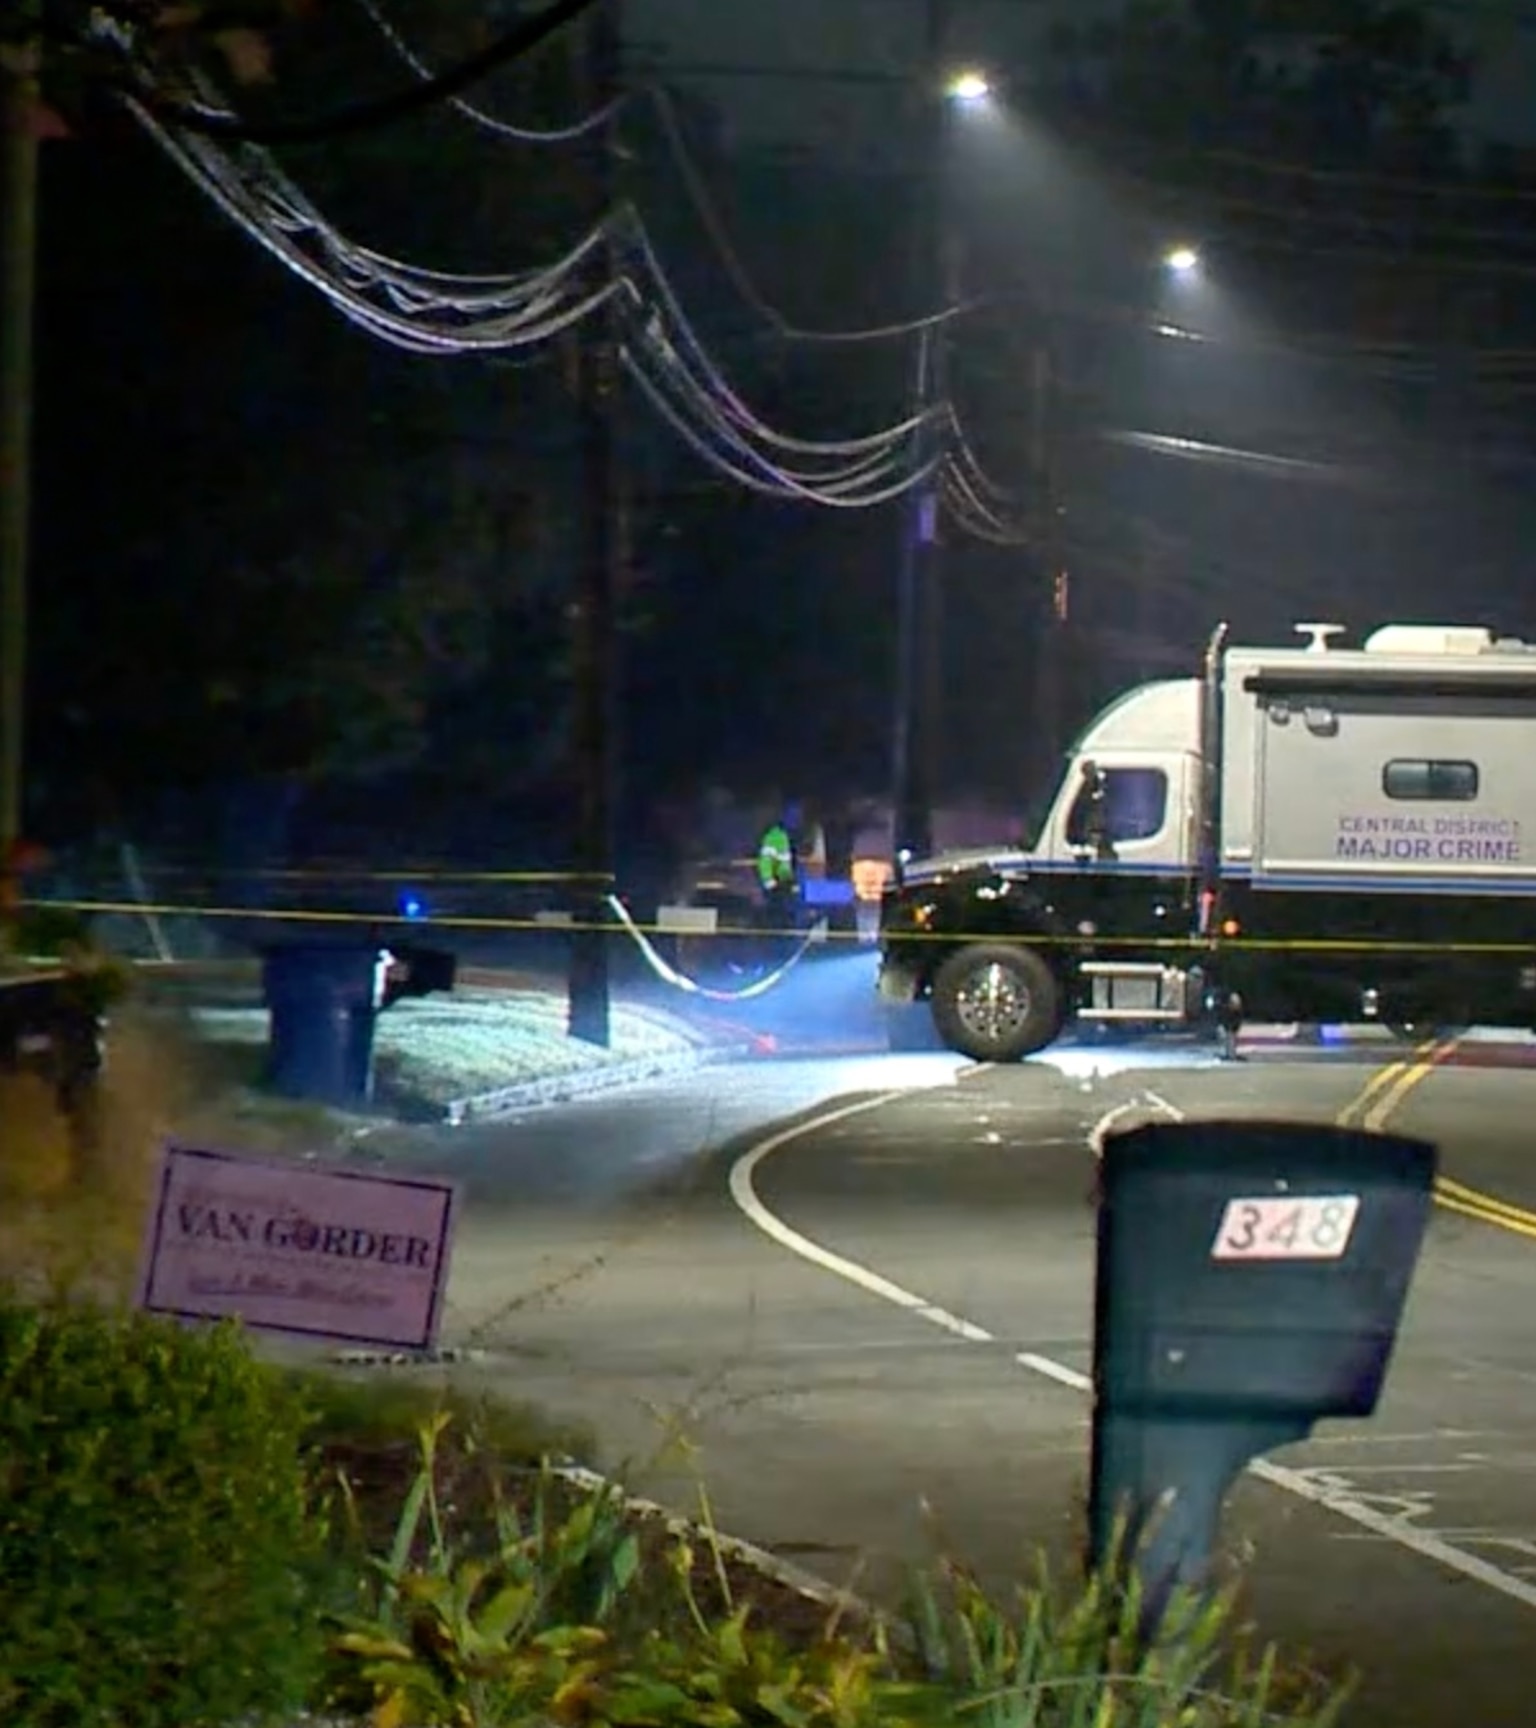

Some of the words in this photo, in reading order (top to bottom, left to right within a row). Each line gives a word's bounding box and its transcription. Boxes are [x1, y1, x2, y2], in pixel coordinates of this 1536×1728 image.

[1339, 816, 1429, 834] CENTRAL
[1434, 818, 1520, 837] DISTRICT
[1337, 836, 1431, 858] MAJOR
[1438, 838, 1521, 861] CRIME
[178, 1203, 255, 1243] VAN
[263, 1214, 431, 1268] GORDER
[1227, 1204, 1346, 1249] 348
